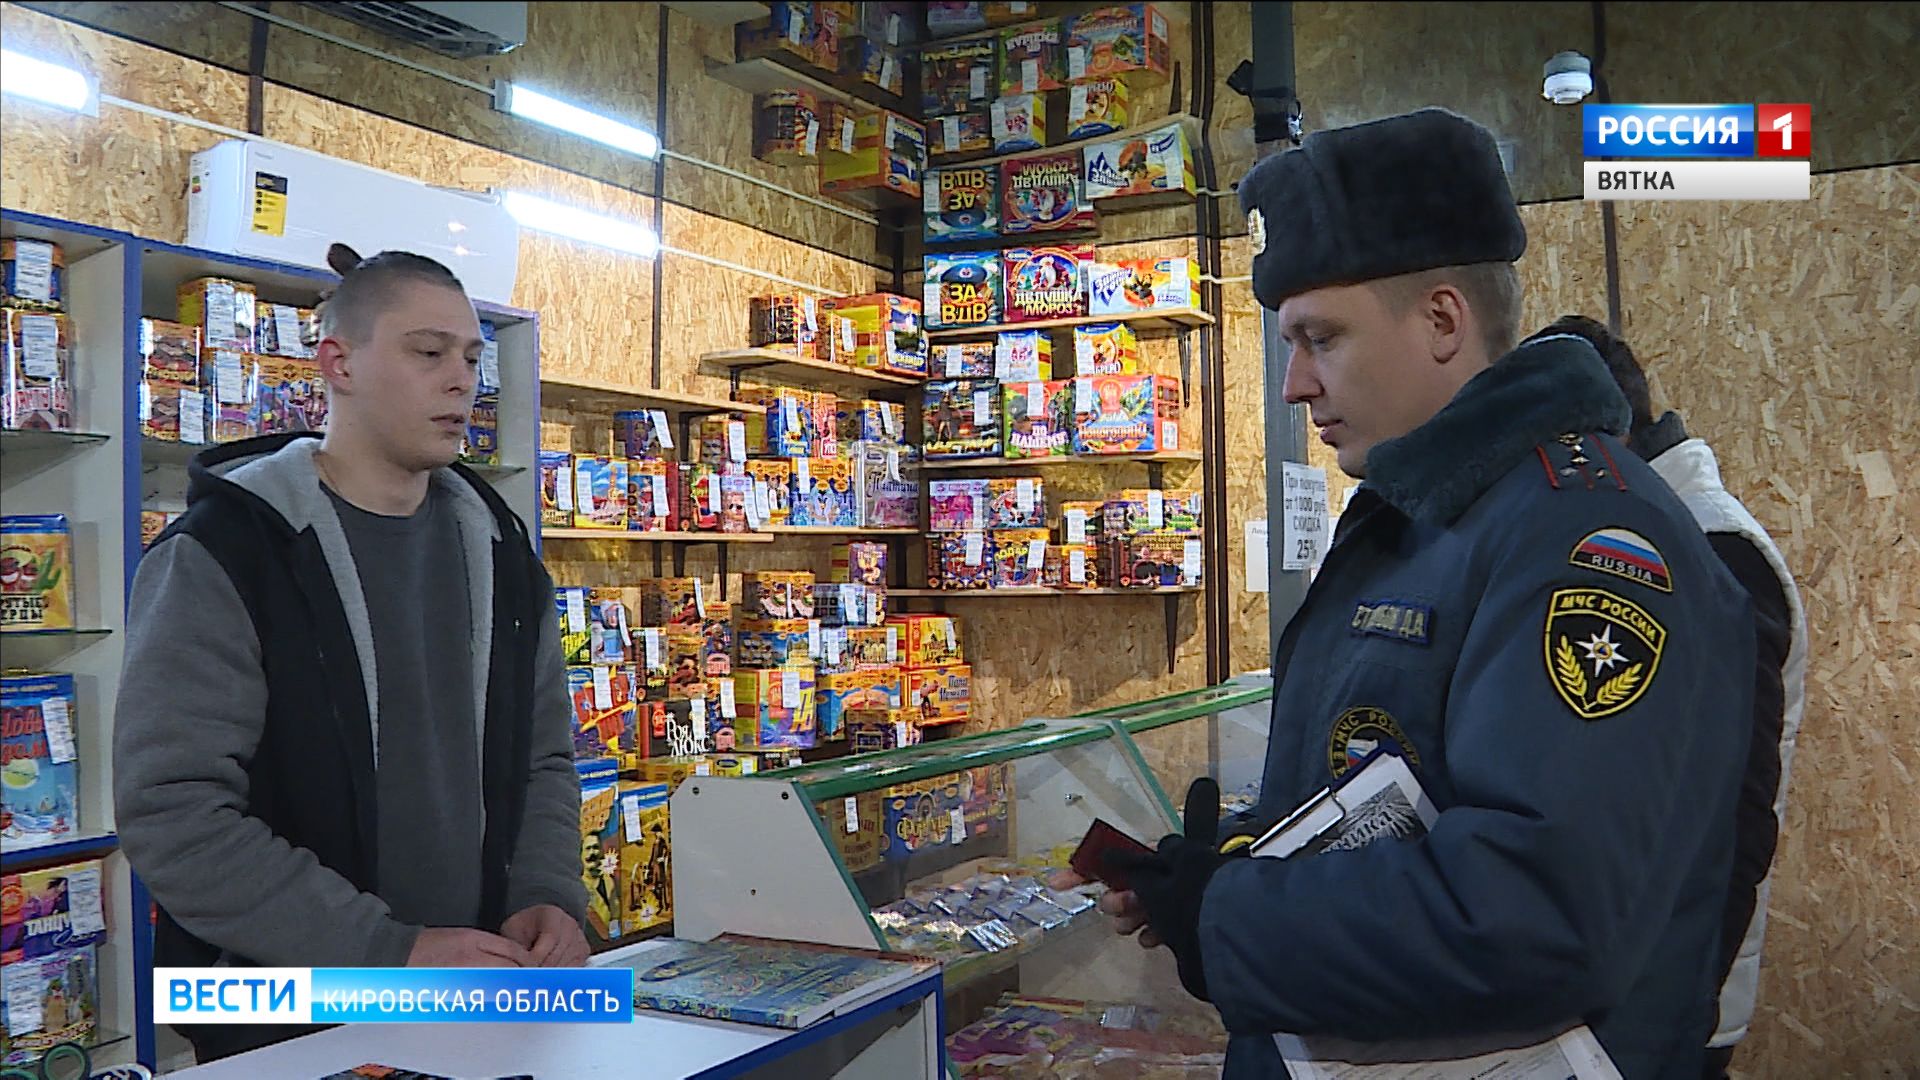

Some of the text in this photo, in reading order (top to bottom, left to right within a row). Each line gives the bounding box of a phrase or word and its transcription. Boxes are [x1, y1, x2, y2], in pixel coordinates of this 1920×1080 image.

[950, 283, 977, 303] ЗА
[1014, 291, 1083, 308] ДЕДУШКА
[942, 303, 988, 323] ВДВ
[1025, 302, 1073, 316] МОРОЗ
[1296, 539, 1318, 560] 25%
[1591, 554, 1653, 583] RUSSIA
[1561, 595, 1656, 642] МЧС РОССИИ
[1335, 714, 1359, 744] МЧС
